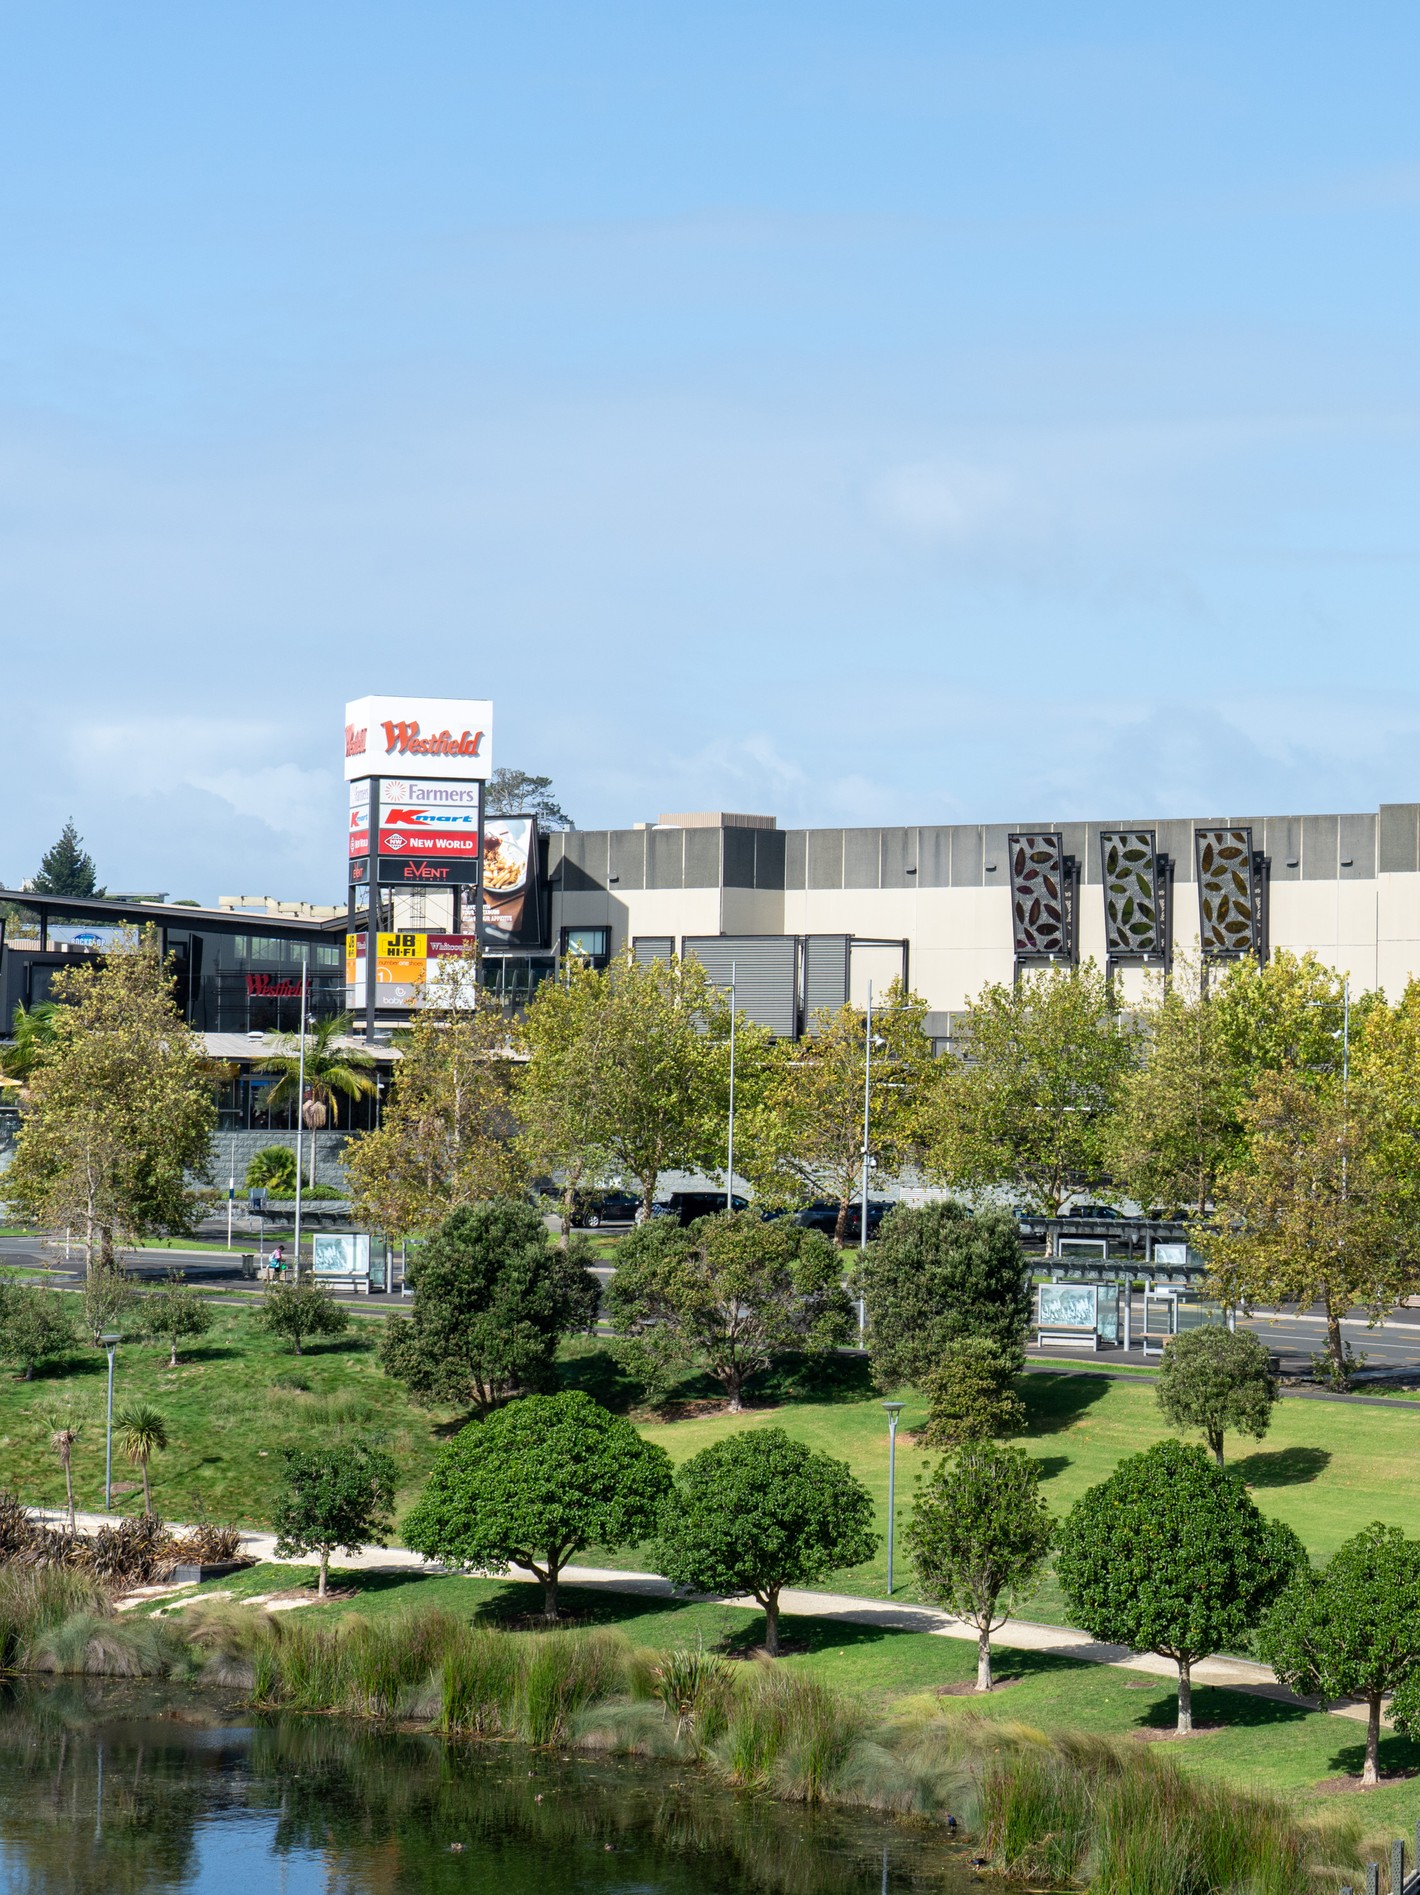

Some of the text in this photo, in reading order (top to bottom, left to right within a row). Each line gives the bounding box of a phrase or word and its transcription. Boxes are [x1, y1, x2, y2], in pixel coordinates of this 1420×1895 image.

[381, 720, 484, 756] Westfield
[409, 784, 474, 802] Farmers
[385, 809, 473, 826] Kmart
[410, 838, 473, 849] NEW WORLD
[404, 861, 450, 878] EVENT
[388, 935, 415, 947] JB
